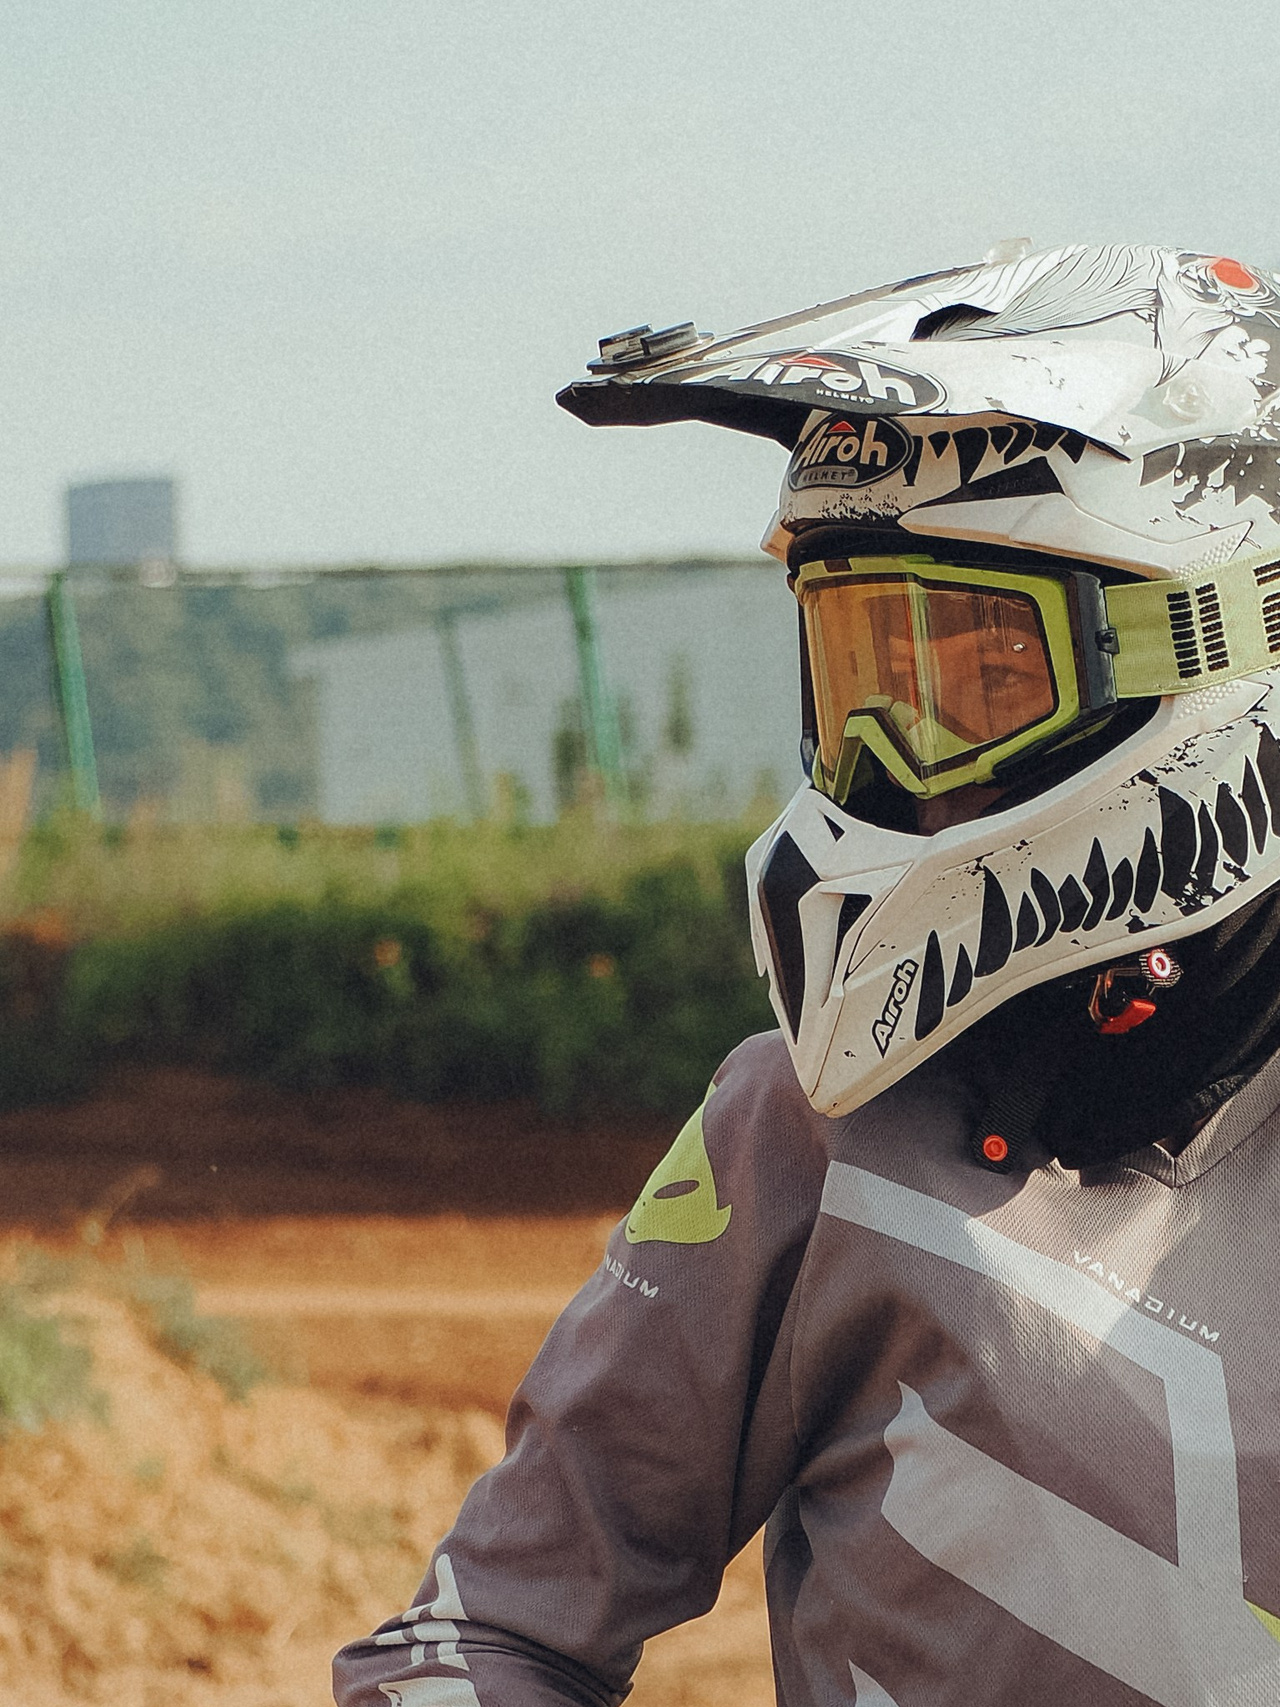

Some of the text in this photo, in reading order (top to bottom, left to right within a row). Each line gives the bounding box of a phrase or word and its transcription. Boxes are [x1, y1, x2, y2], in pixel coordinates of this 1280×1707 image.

[682, 357, 917, 406] Airoh
[794, 420, 888, 472] Airoh
[871, 959, 919, 1058] Airoh
[1074, 1250, 1220, 1342] VANADIUM
